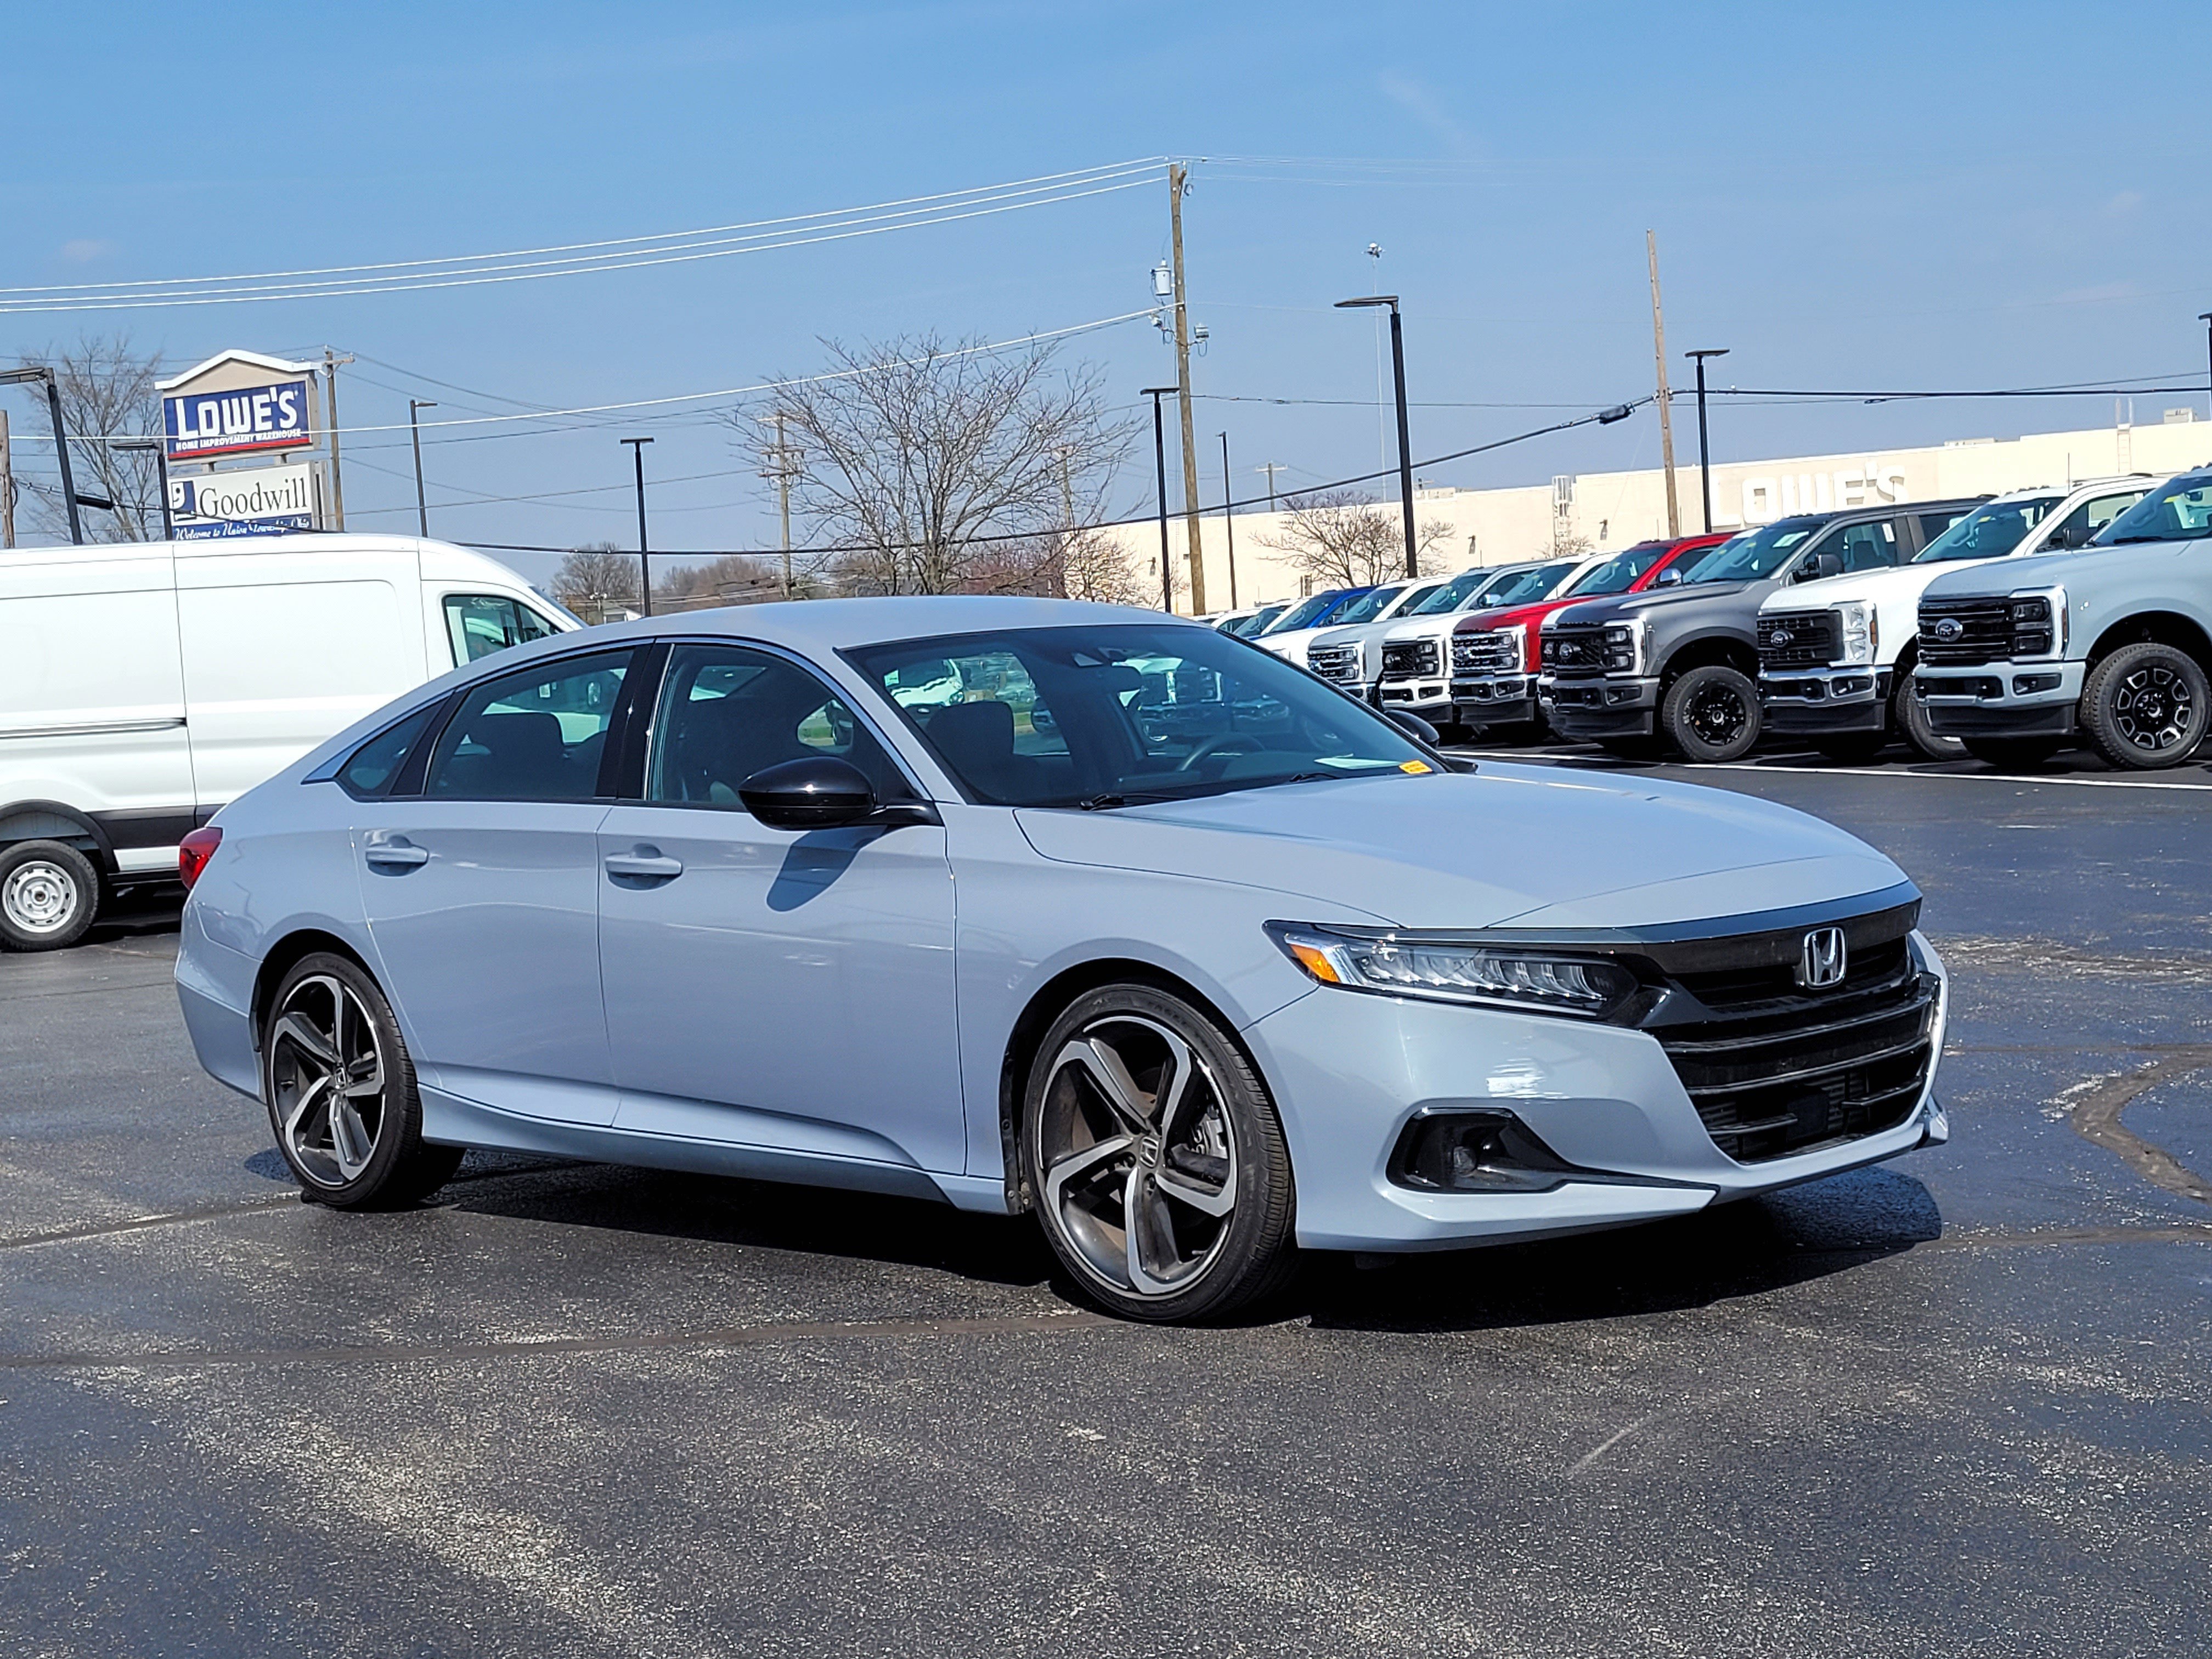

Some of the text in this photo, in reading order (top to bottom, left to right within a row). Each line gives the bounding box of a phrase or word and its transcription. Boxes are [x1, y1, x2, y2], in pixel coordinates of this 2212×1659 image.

[175, 386, 297, 441] LOWE'S
[176, 440, 198, 452] HOME
[200, 477, 307, 518] Goodwill
[175, 527, 212, 540] Welcome
[213, 528, 221, 537] to
